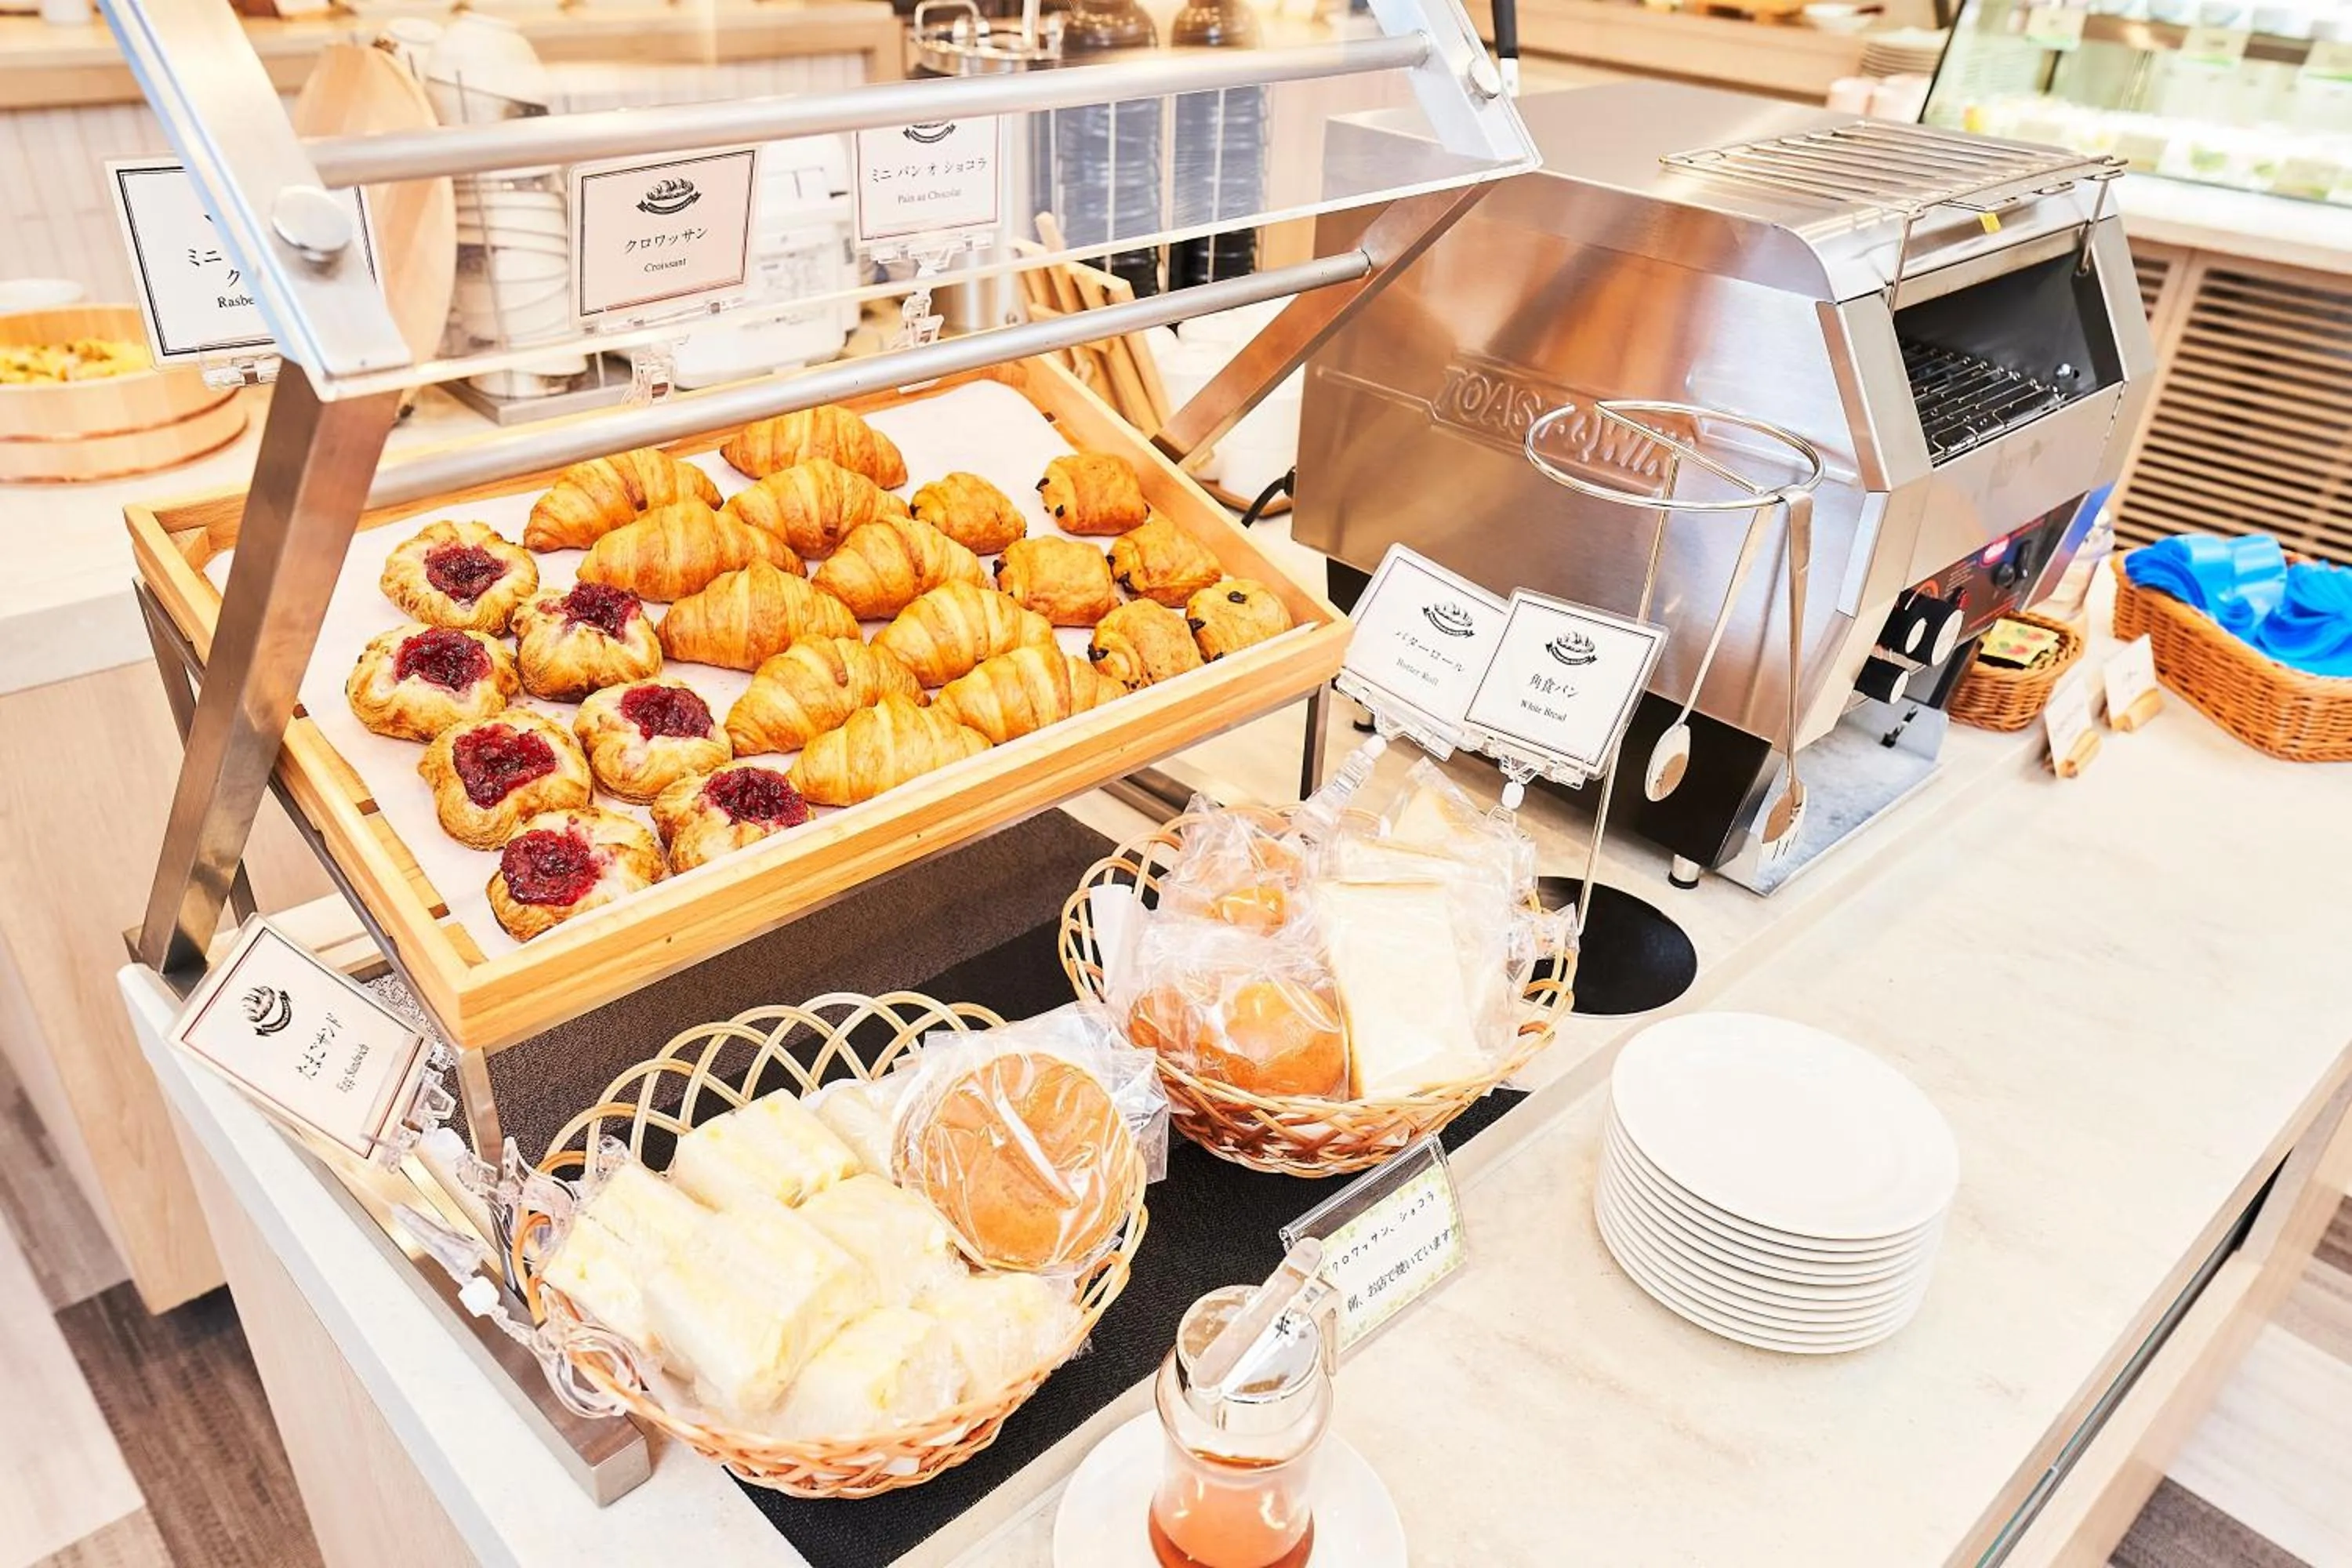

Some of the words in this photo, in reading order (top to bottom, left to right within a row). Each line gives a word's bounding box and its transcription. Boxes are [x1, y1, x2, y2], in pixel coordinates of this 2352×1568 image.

[871, 168, 891, 183] ミニ
[944, 157, 987, 174] ショコラ
[625, 227, 708, 255] クロワッサン
[187, 248, 222, 267] ミニ
[644, 257, 687, 274] Croissant
[295, 1011, 343, 1081] たまごサンド
